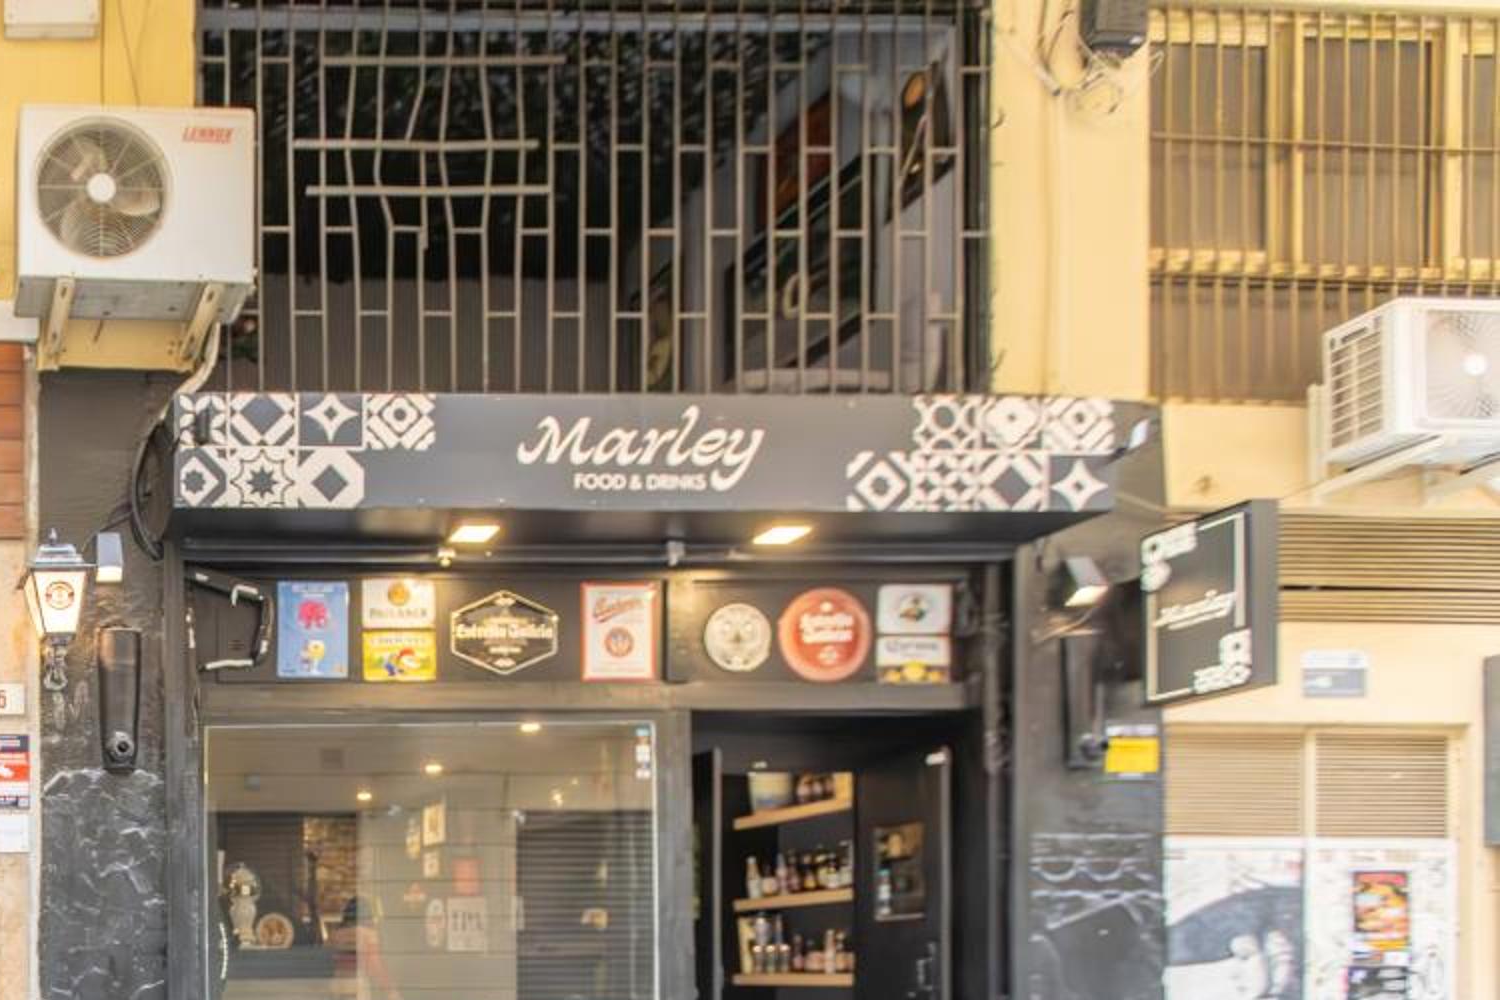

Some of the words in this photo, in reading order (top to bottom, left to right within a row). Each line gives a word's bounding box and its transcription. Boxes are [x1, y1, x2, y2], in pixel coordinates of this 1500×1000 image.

[181, 127, 234, 144] LENNOX
[517, 405, 765, 491] Marley
[573, 473, 627, 491] FOOD
[629, 474, 643, 490] &
[646, 473, 707, 491] DRINKS
